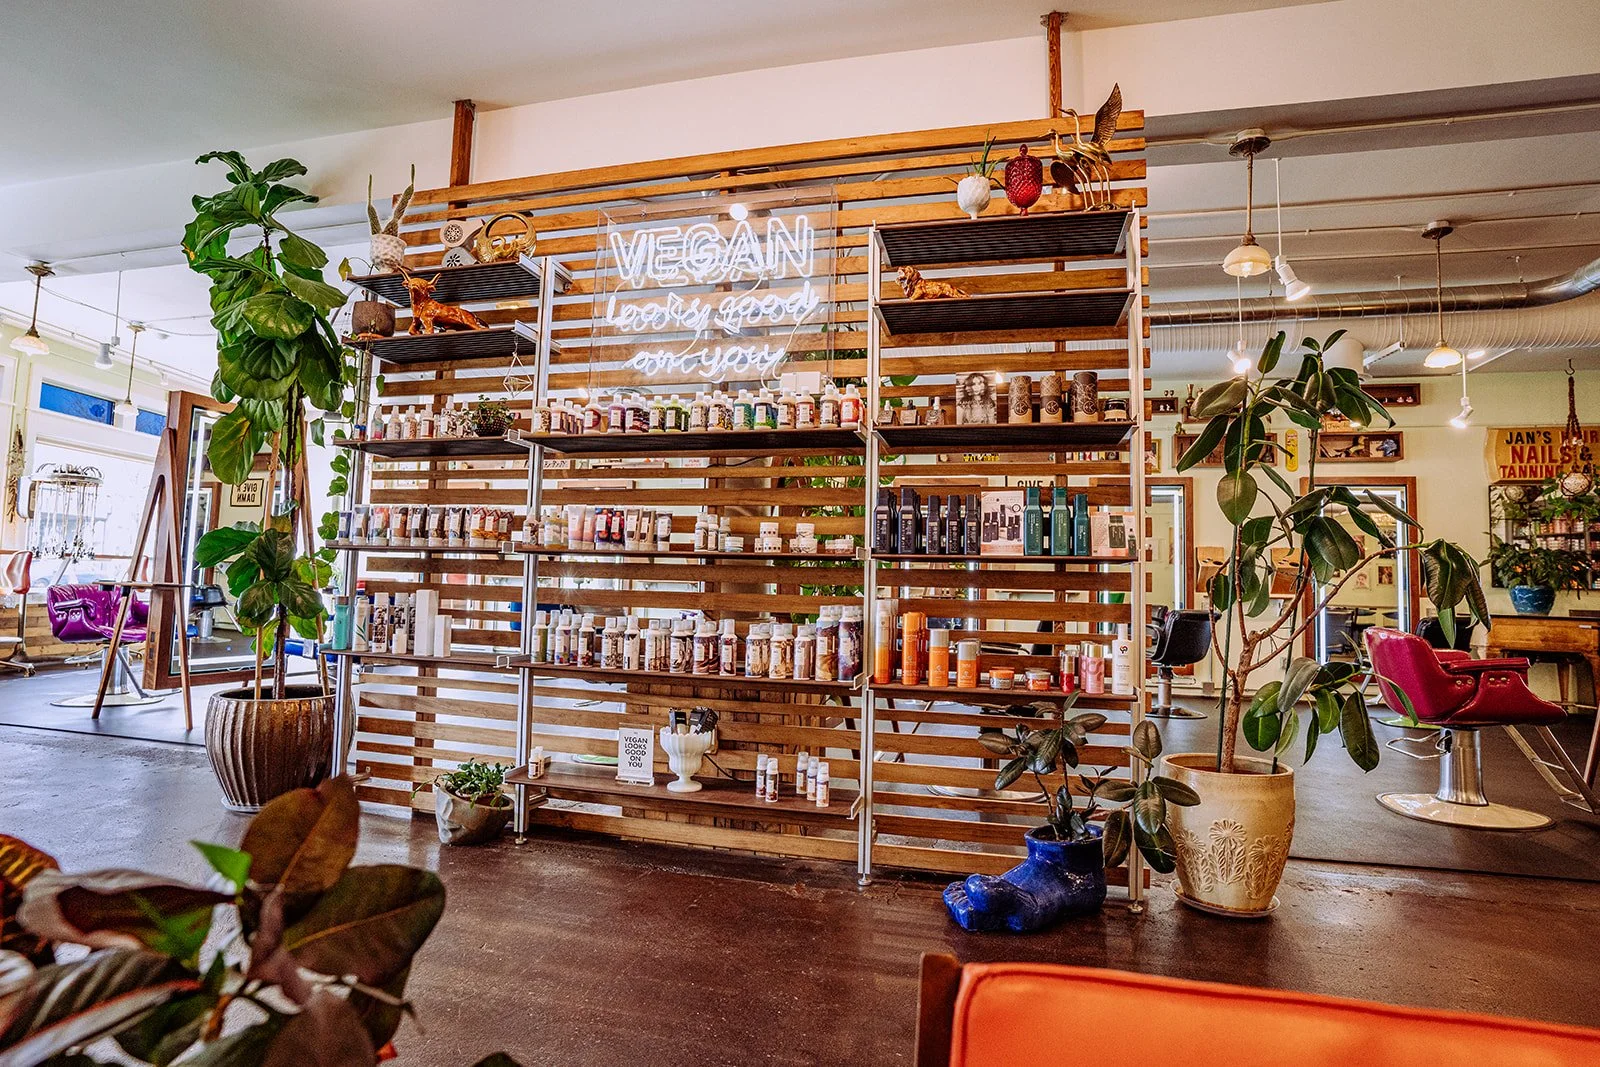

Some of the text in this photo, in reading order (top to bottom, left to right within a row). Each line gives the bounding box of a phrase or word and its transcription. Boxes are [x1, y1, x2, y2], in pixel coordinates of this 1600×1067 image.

[609, 214, 813, 287] VEGAN
[1505, 431, 1552, 444] JAN'S
[1511, 445, 1572, 464] NAILS
[624, 736, 648, 744] VEGAN
